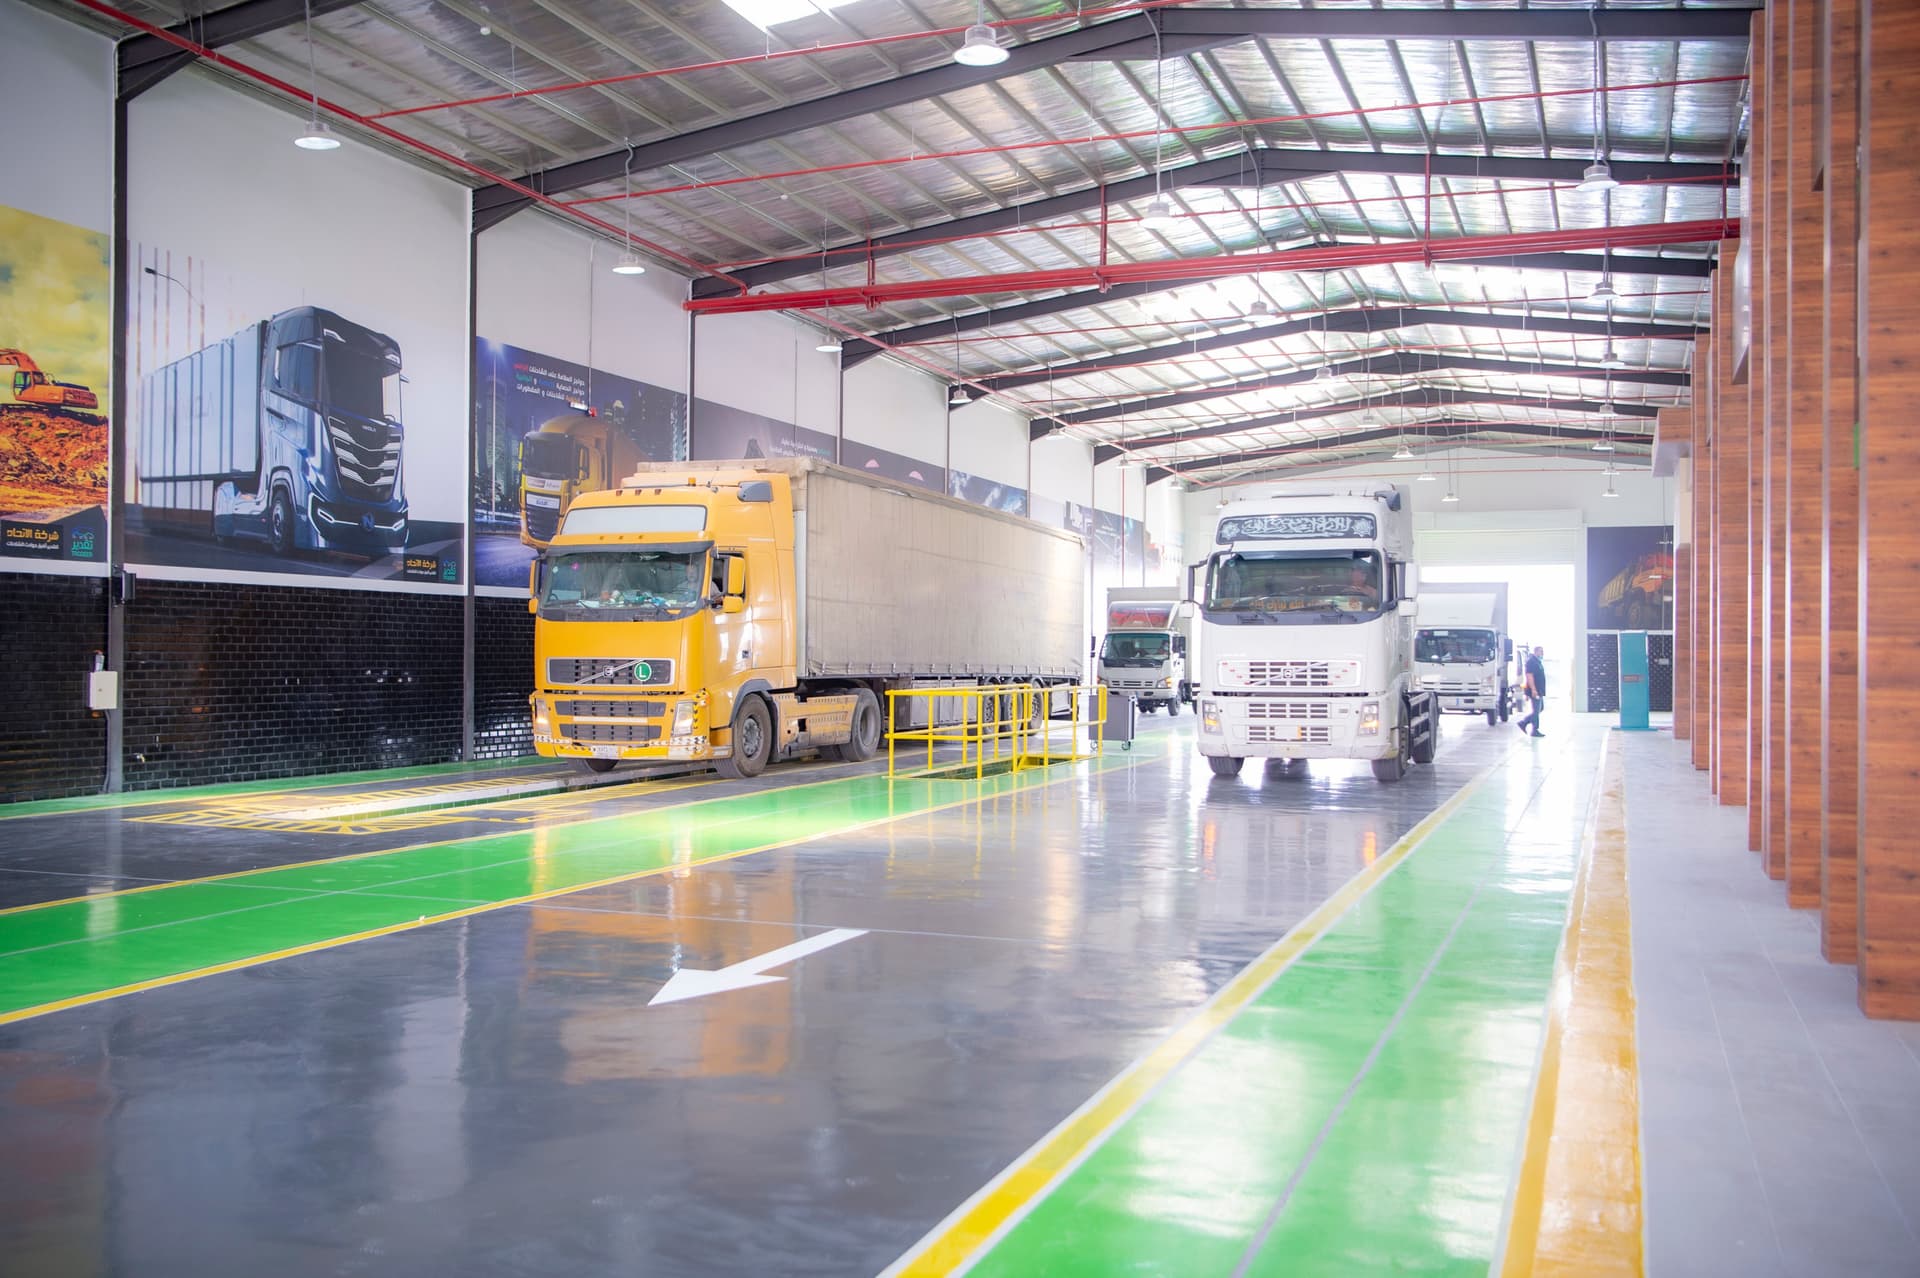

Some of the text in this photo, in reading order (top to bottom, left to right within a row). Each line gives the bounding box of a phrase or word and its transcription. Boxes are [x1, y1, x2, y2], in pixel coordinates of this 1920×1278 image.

[6, 528, 60, 542] شركة الاتحاد
[639, 665, 647, 678] L
